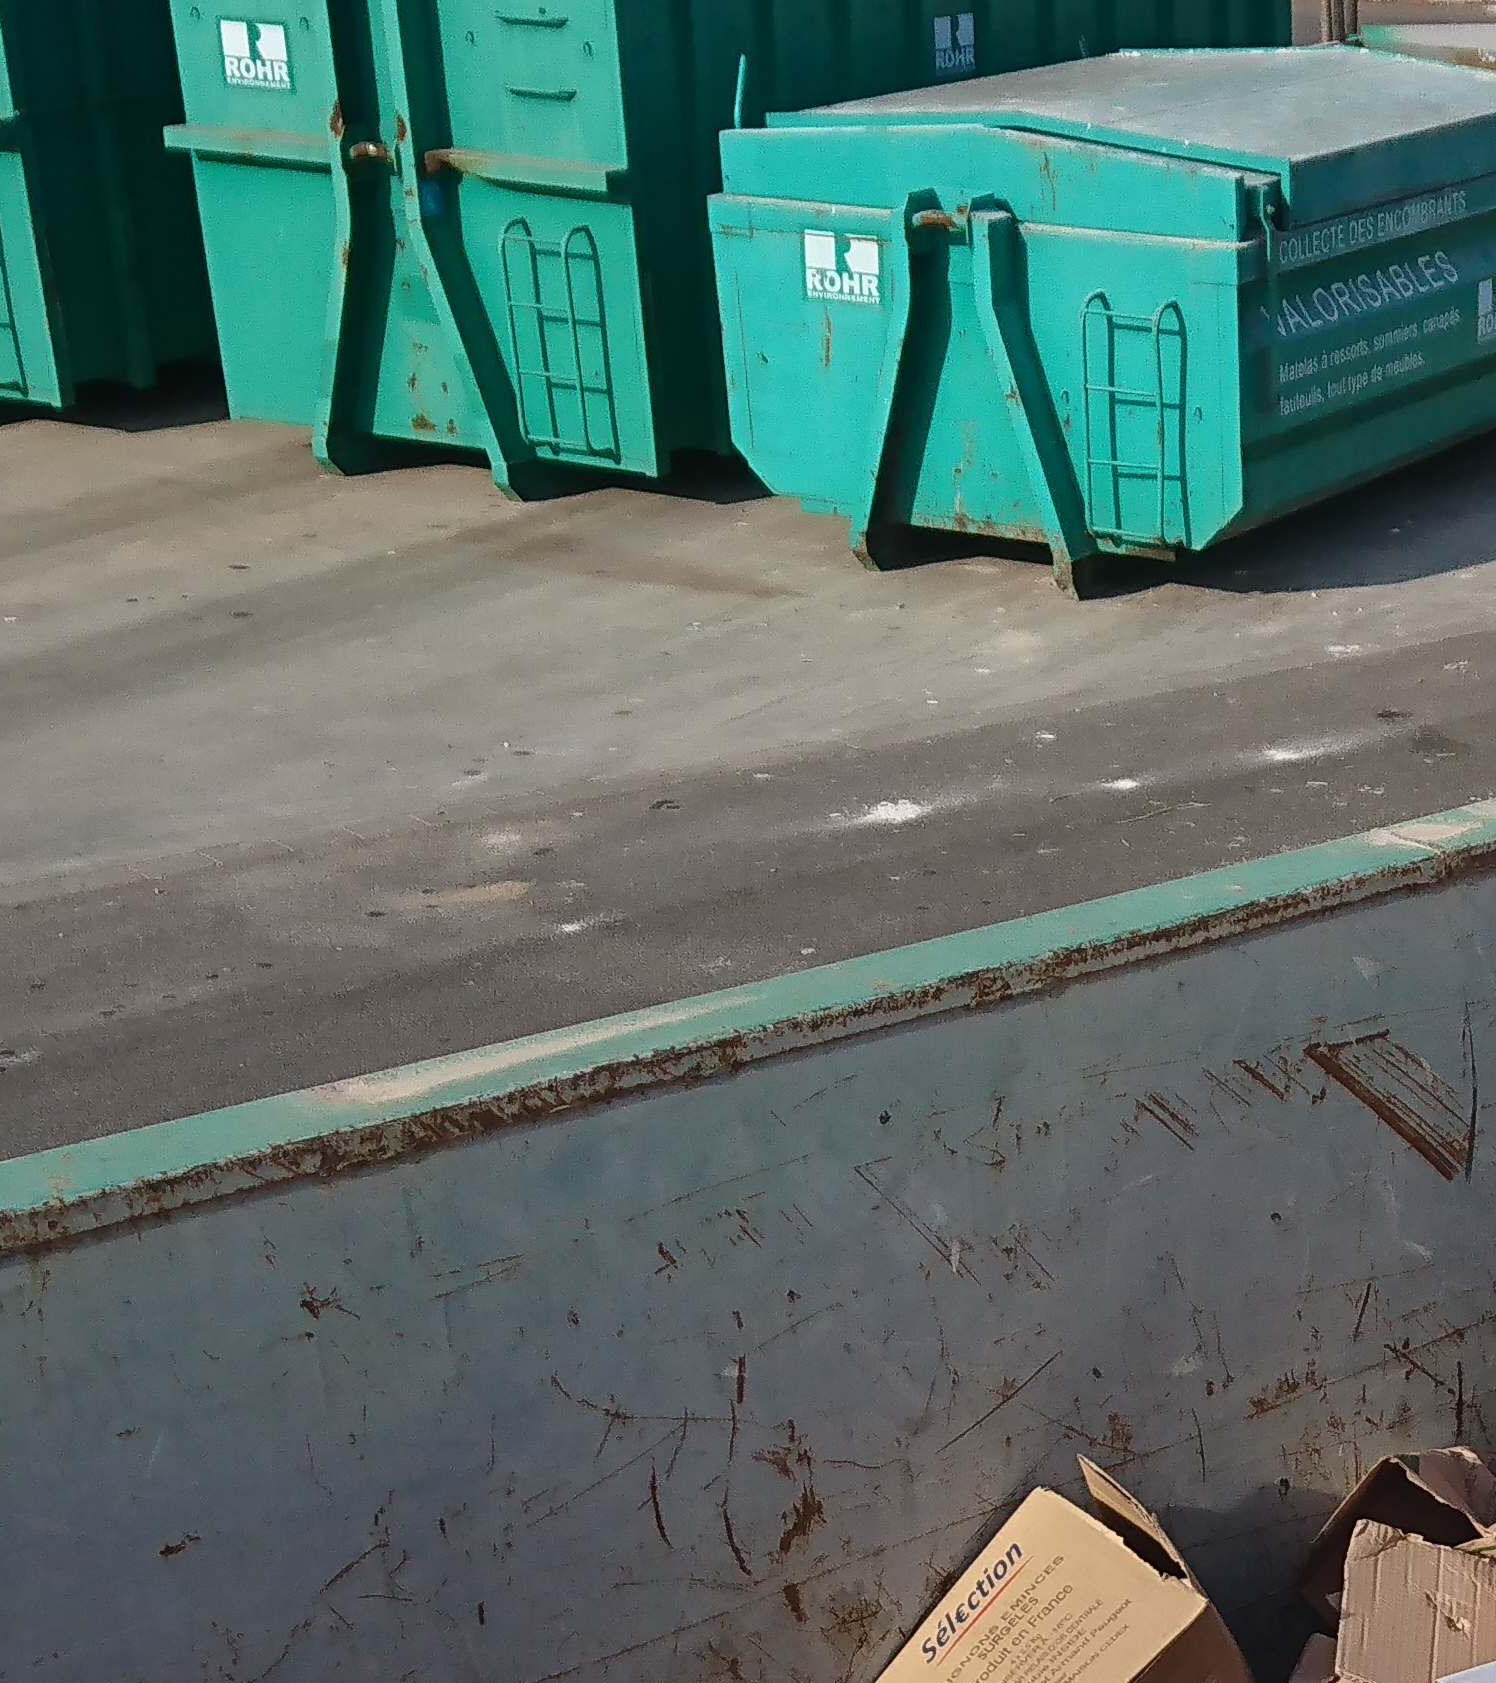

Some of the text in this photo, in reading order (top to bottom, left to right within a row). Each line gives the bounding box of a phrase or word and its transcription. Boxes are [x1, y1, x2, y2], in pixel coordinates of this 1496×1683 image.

[225, 55, 291, 82] ROHR
[935, 45, 975, 69] ROHR
[1279, 187, 1468, 265] COLLECTE DES ENCOMBRANTS
[806, 268, 880, 297] ROHR
[1260, 250, 1460, 338] VALORISABLES
[1000, 1554, 1066, 1621] EMINCES
[1011, 1628, 1031, 1650] en
[1027, 1583, 1075, 1629] France
[1051, 1634, 1091, 1678] Armand
[1089, 1598, 1133, 1641] Peugeot
